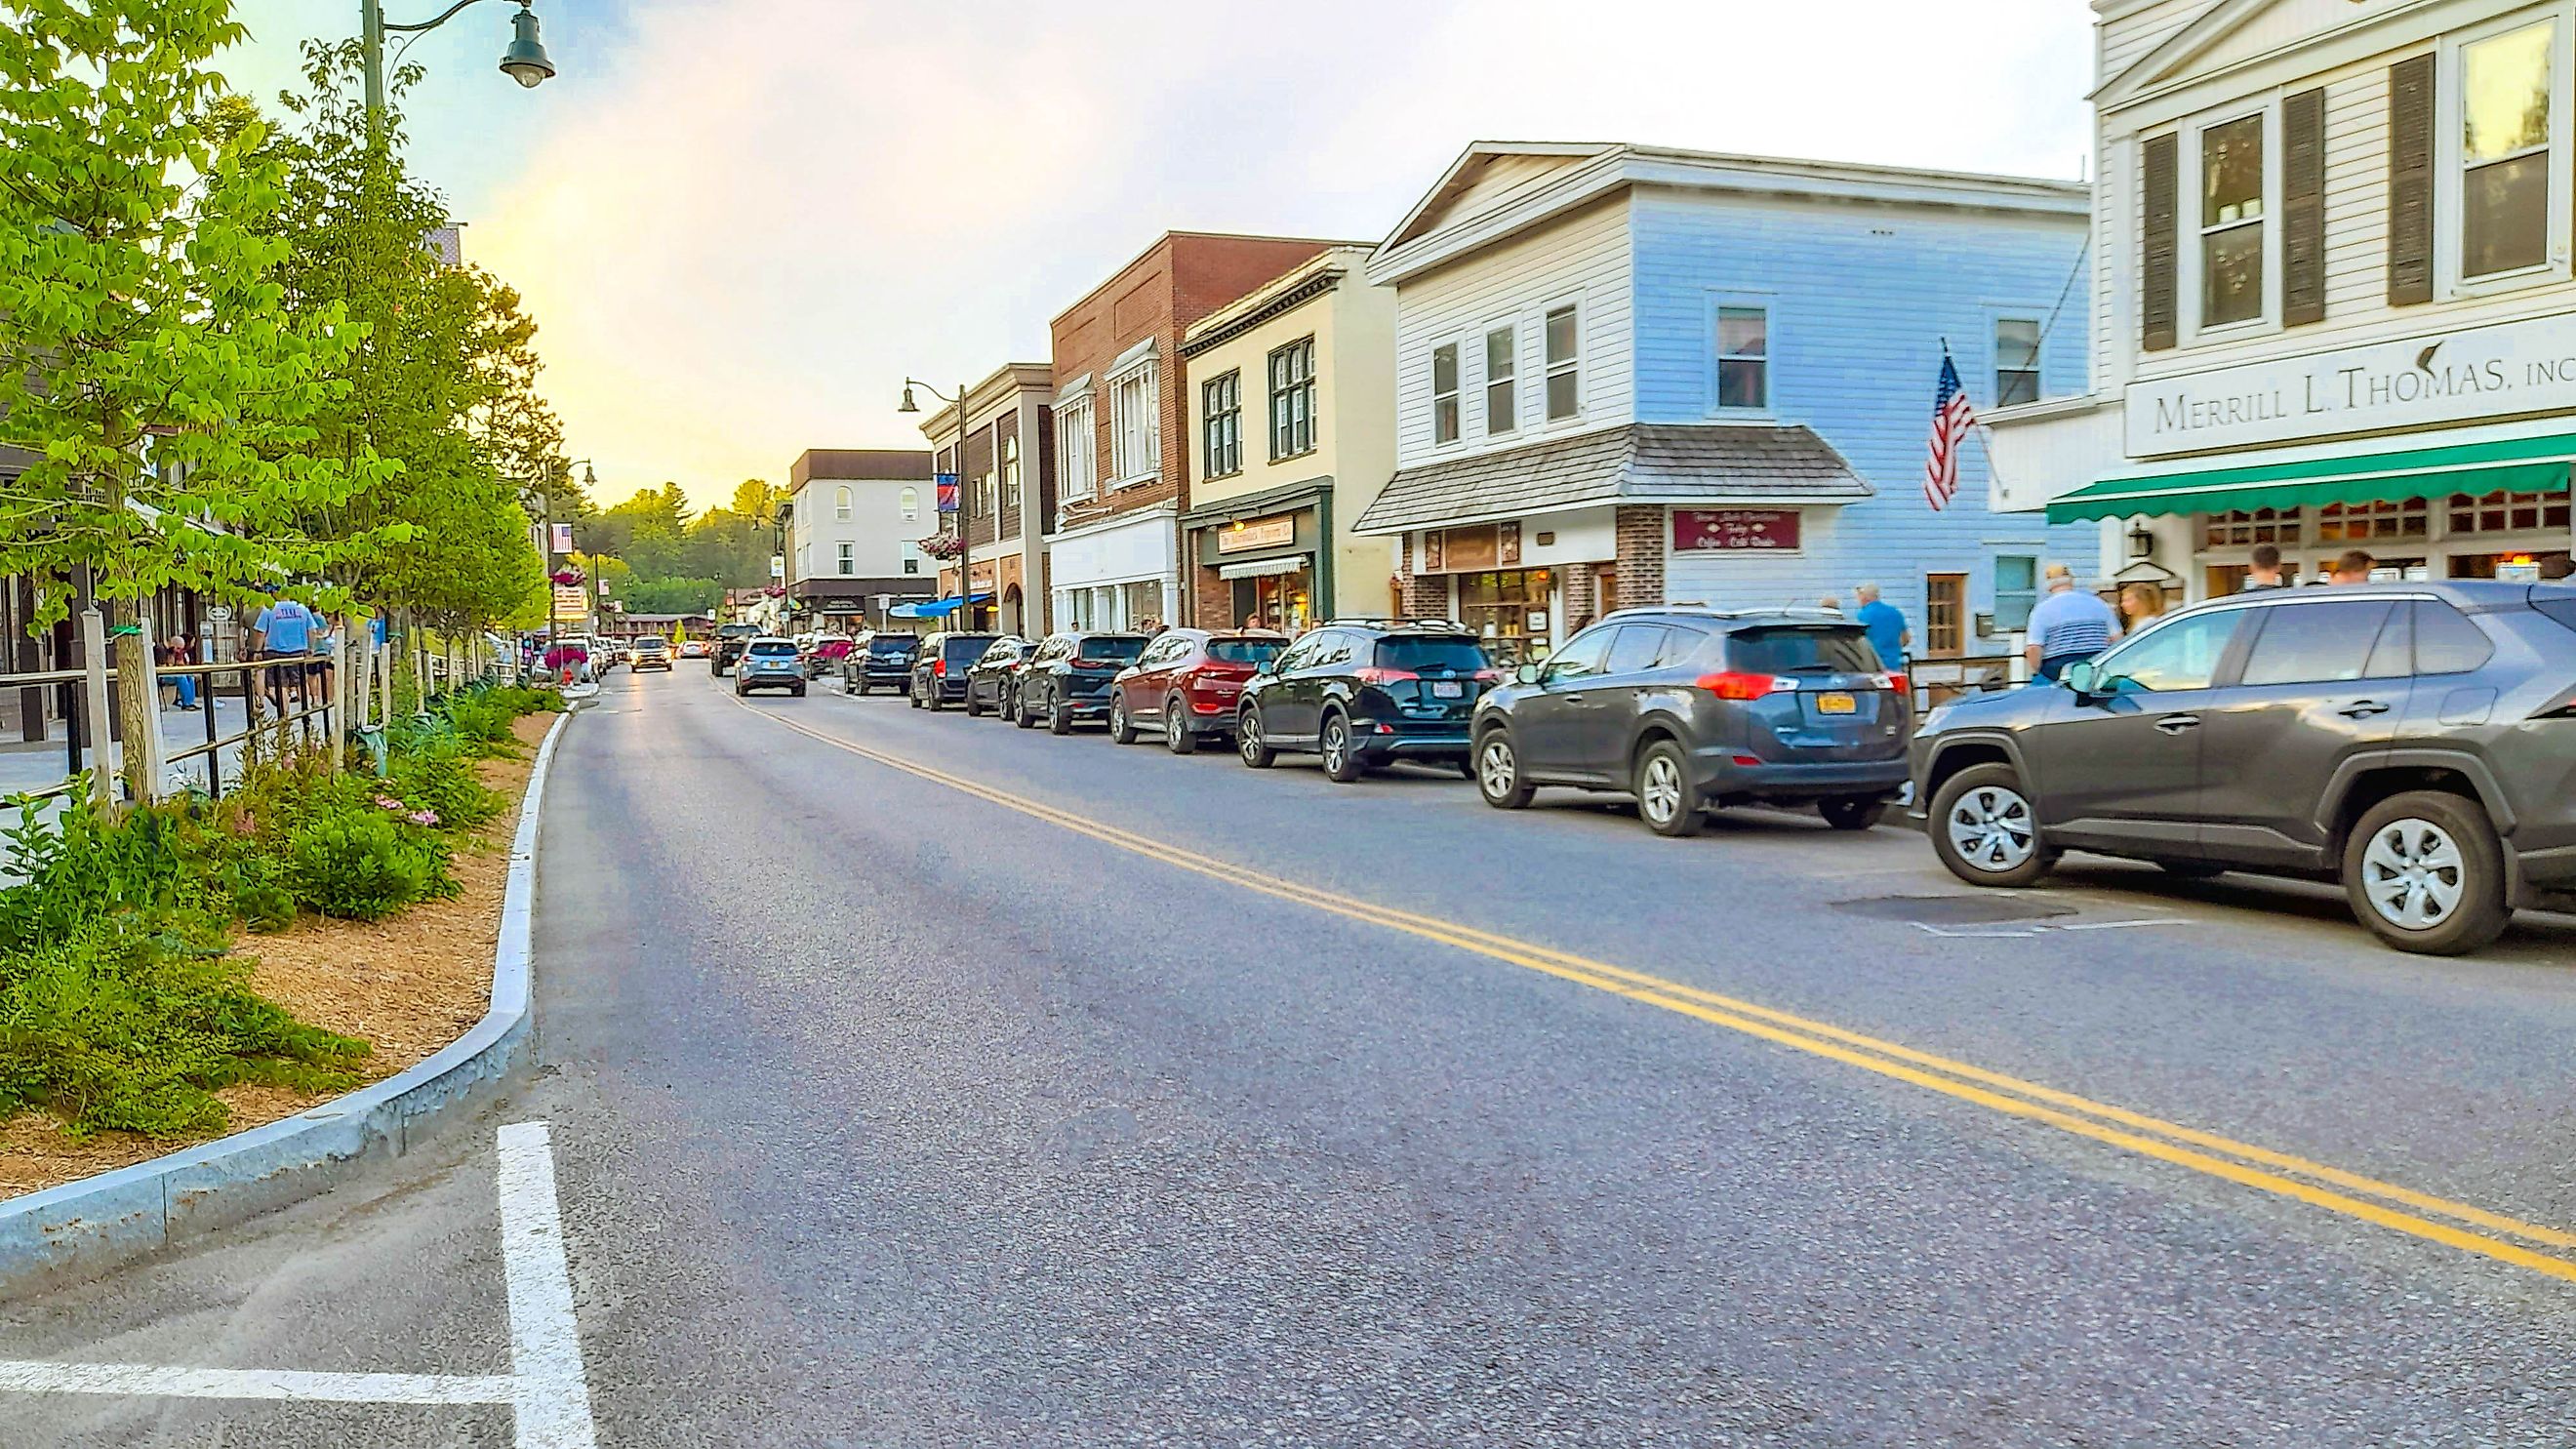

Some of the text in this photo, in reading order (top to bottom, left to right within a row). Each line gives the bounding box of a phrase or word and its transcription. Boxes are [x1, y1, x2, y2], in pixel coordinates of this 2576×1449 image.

[2154, 390, 2287, 433] MERRILL
[2303, 375, 2333, 415] L.
[2526, 357, 2576, 386] INC
